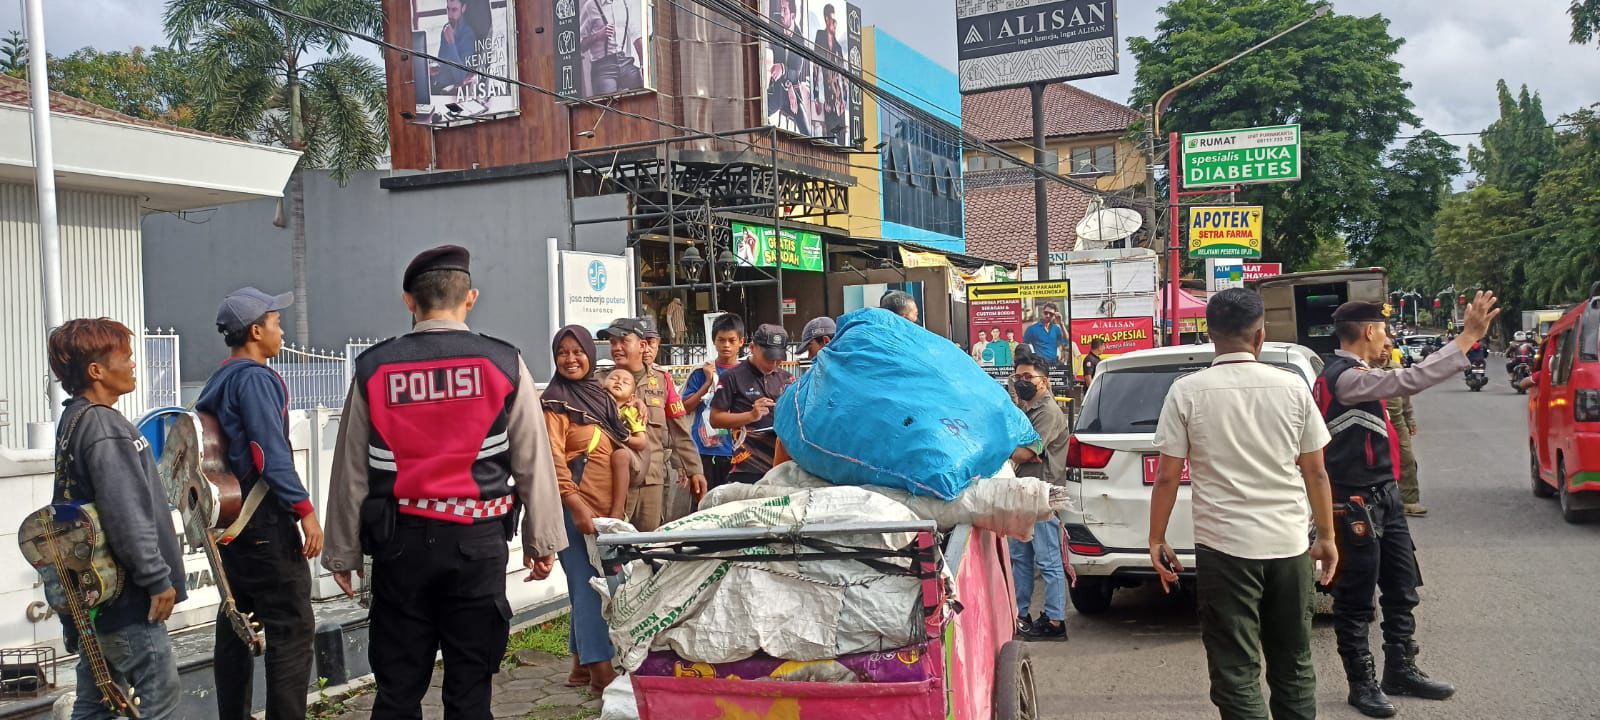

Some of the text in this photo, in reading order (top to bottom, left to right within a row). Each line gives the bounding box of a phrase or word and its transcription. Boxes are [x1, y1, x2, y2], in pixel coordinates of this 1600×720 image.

[996, 1, 1107, 39] ALISAN
[1077, 24, 1106, 36] ALISAN
[474, 35, 505, 51] INGAT
[464, 51, 505, 67] KEMEJA
[456, 82, 507, 103] ALISAN
[1200, 136, 1237, 147] RUMAT
[1191, 146, 1291, 166] spesialis LUKA
[1191, 161, 1292, 181] DIABETES
[1193, 211, 1250, 228] APOTEK
[1198, 229, 1253, 239] SETRA FARMA
[569, 295, 583, 304] jasa
[1102, 320, 1135, 329] ALISAN
[1111, 329, 1147, 342] SPESIAL
[388, 367, 481, 403] POLISI
